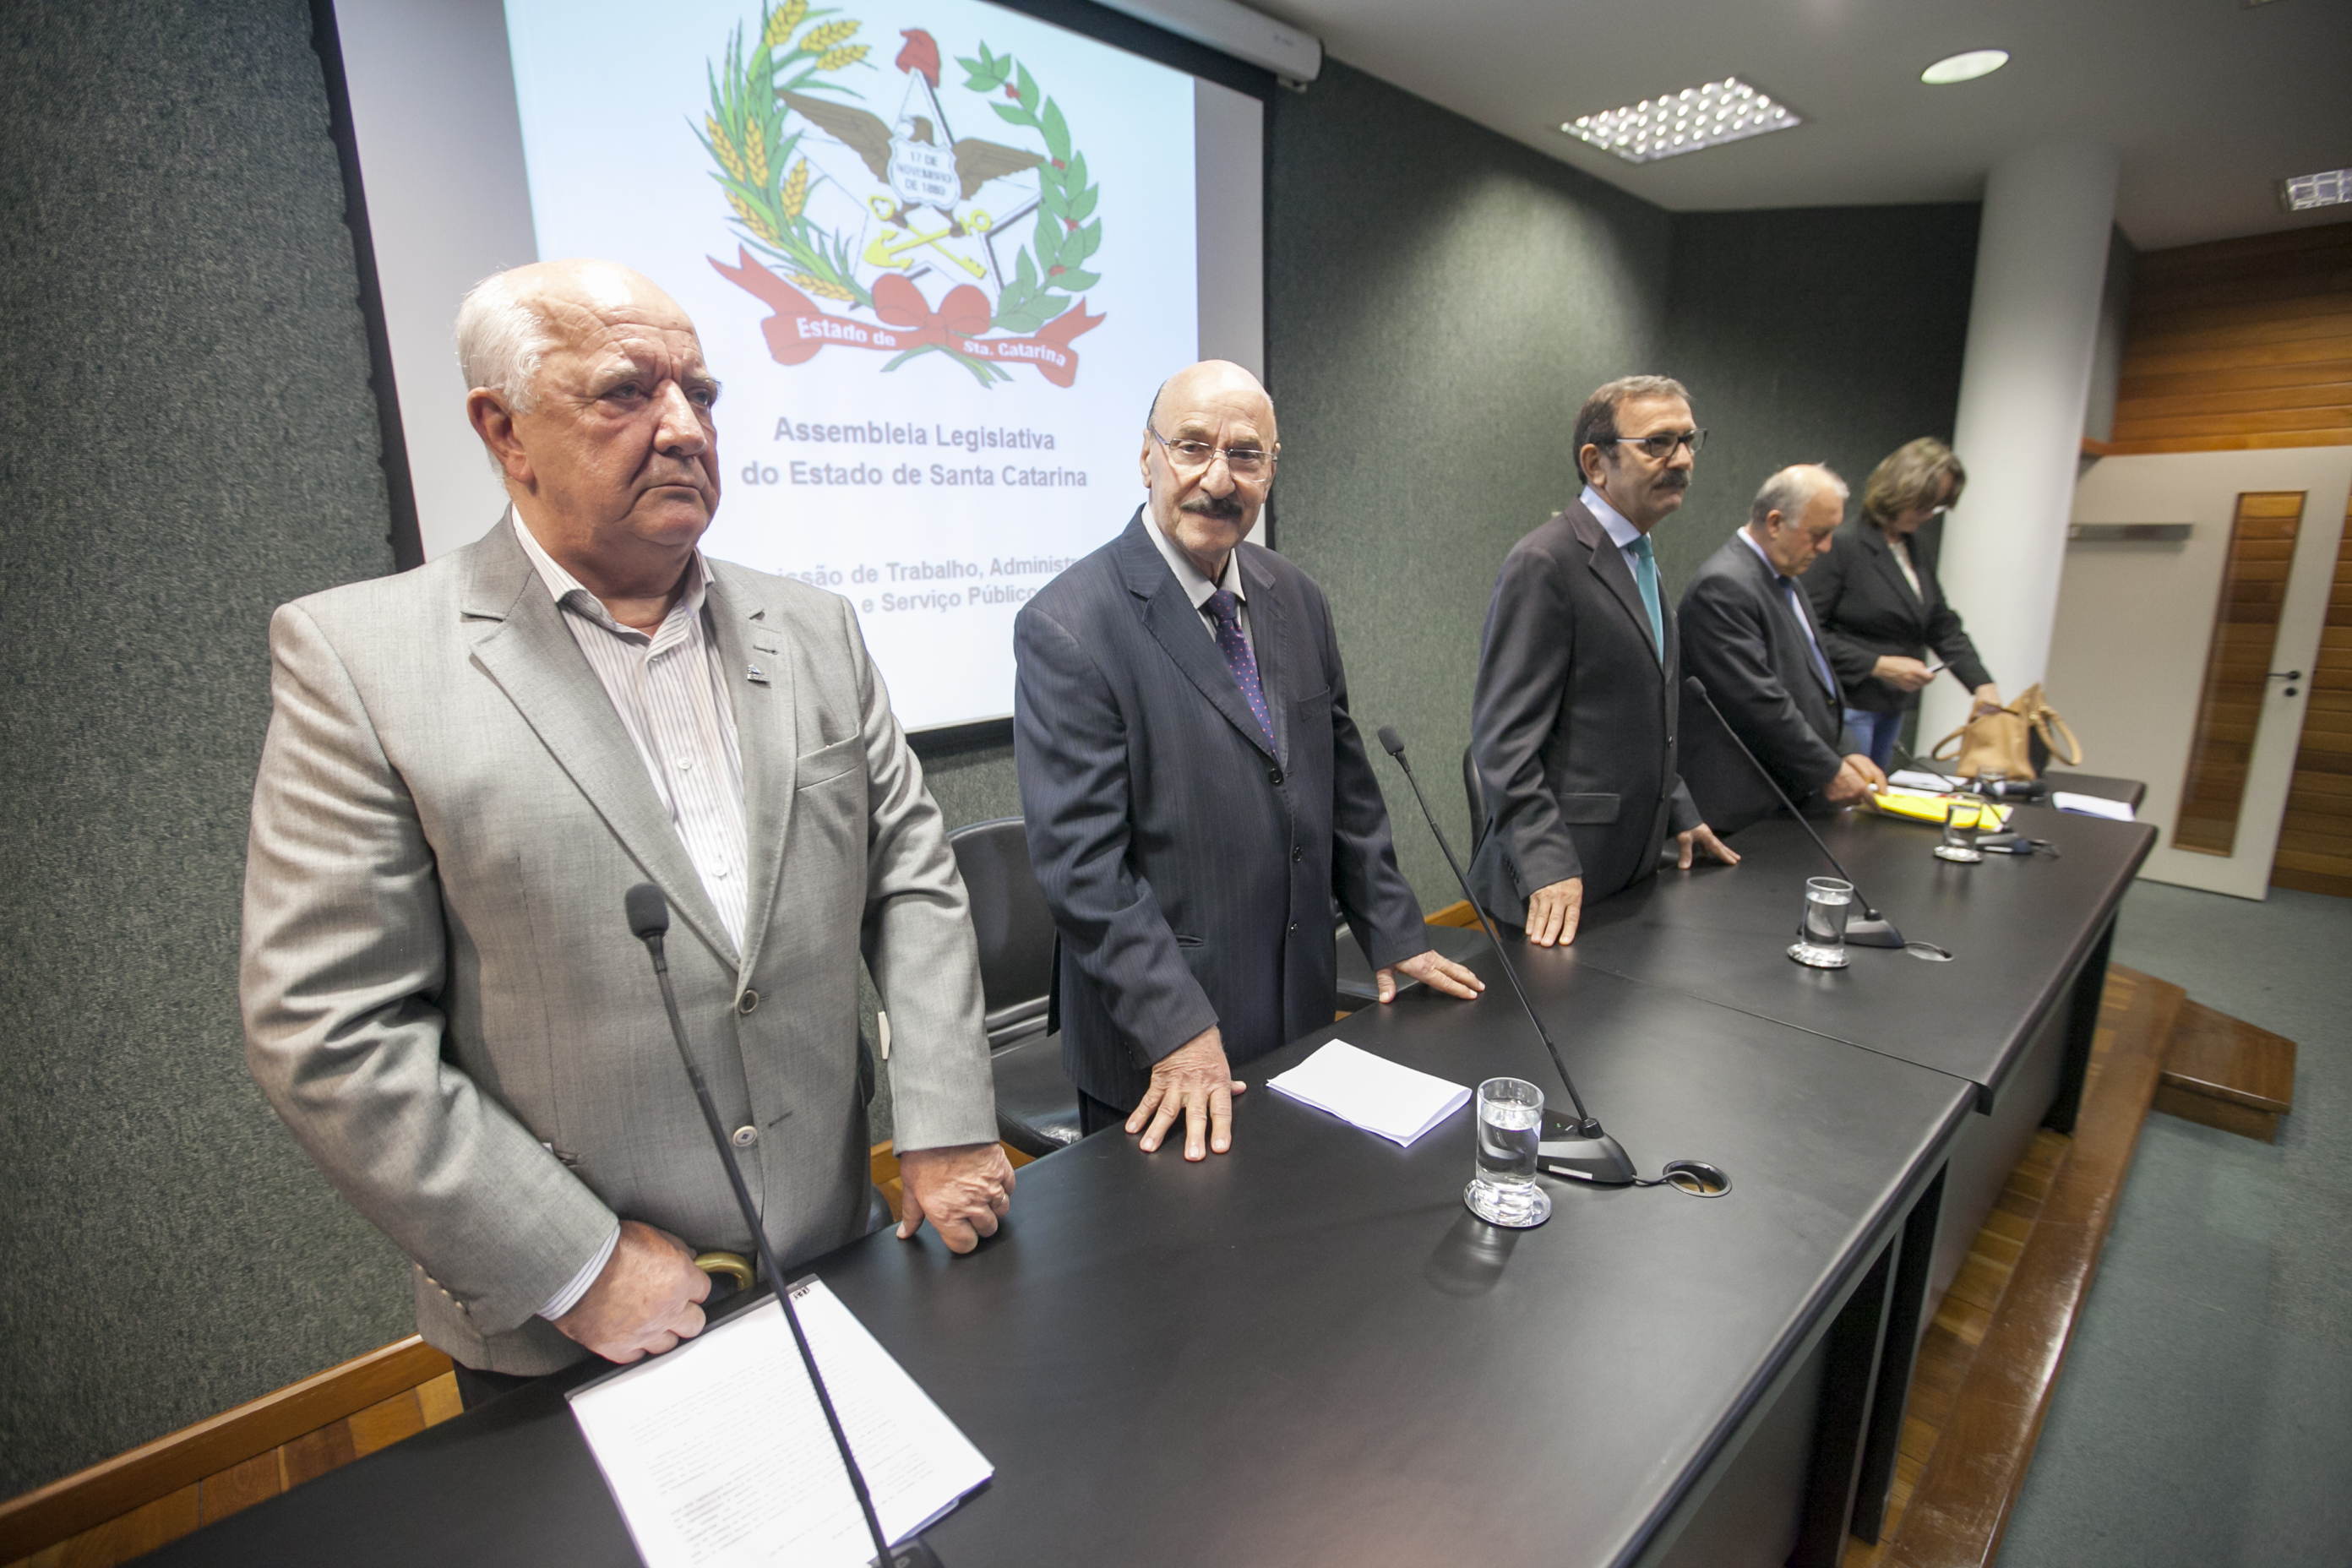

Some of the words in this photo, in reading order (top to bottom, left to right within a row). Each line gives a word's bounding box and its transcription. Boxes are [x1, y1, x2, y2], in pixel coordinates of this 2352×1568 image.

[910, 151, 922, 162] 17
[924, 154, 938, 166] DE
[905, 178, 918, 191] DE
[795, 317, 868, 342] Estado
[873, 330, 896, 347] de
[963, 340, 994, 356] Sta.
[998, 342, 1067, 368] Catarina
[774, 416, 928, 445] Assembleia
[936, 424, 1055, 453] Legislativa
[741, 460, 779, 485] do
[790, 460, 884, 486] Estado
[892, 463, 922, 486] de
[929, 464, 995, 486] Santa
[1002, 465, 1087, 487] Catarina
[851, 564, 879, 585] de
[885, 558, 984, 582] Trabalho,
[861, 598, 874, 613] e
[881, 589, 961, 612] Serviço
